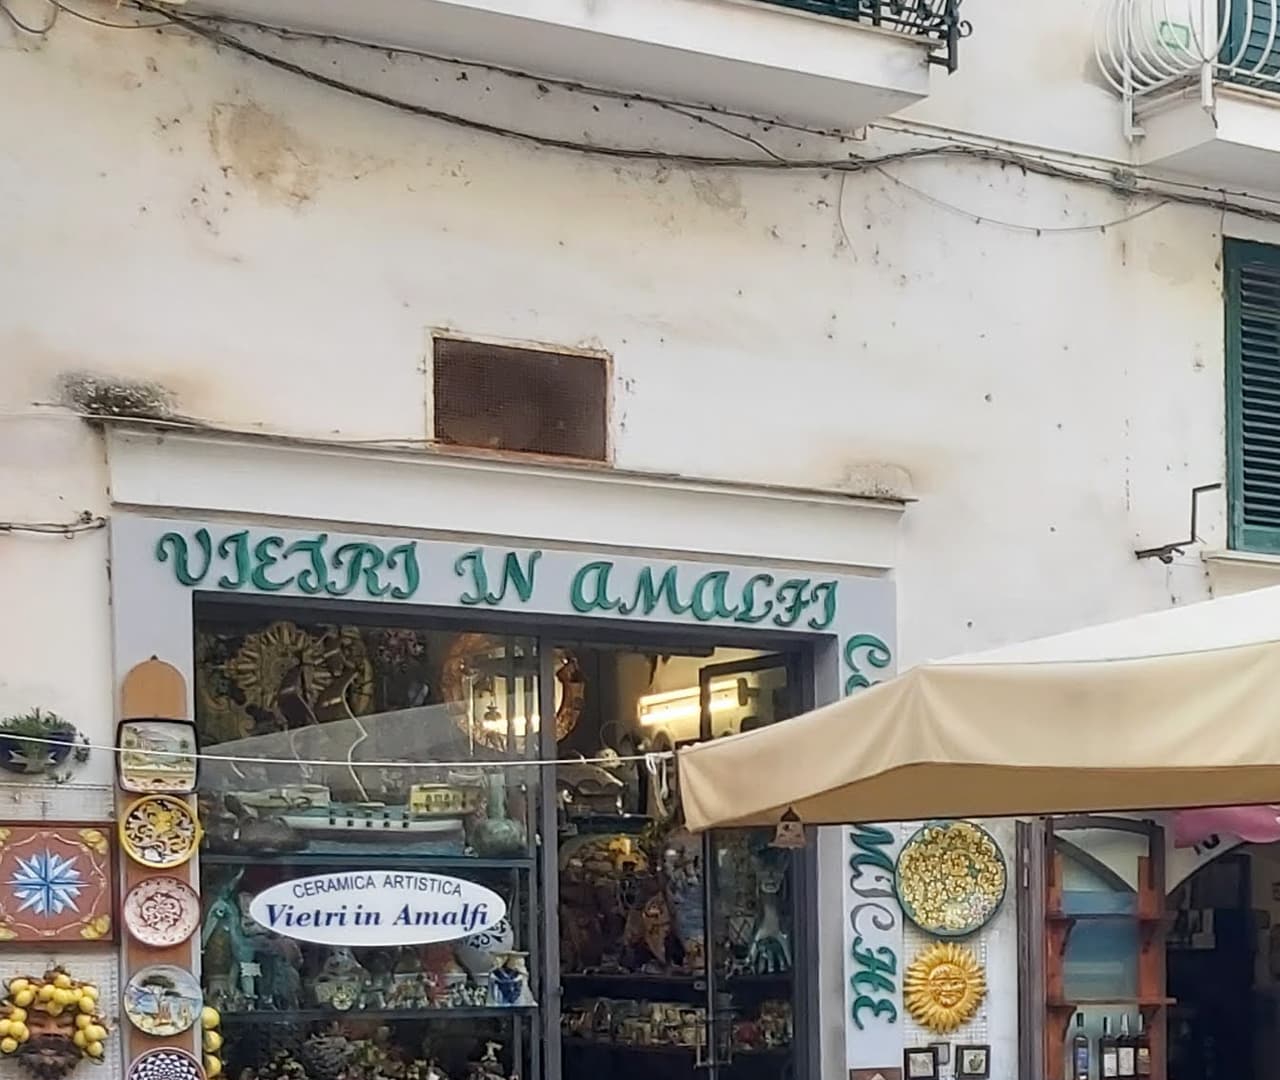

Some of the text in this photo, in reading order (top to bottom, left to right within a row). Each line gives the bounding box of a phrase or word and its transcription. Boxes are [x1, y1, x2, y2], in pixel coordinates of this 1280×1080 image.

[157, 528, 838, 630] VIETRI IN AMALFI
[292, 874, 462, 899] CERAMICA ARTISTICA
[266, 903, 488, 931] Vietri in Amalfi
